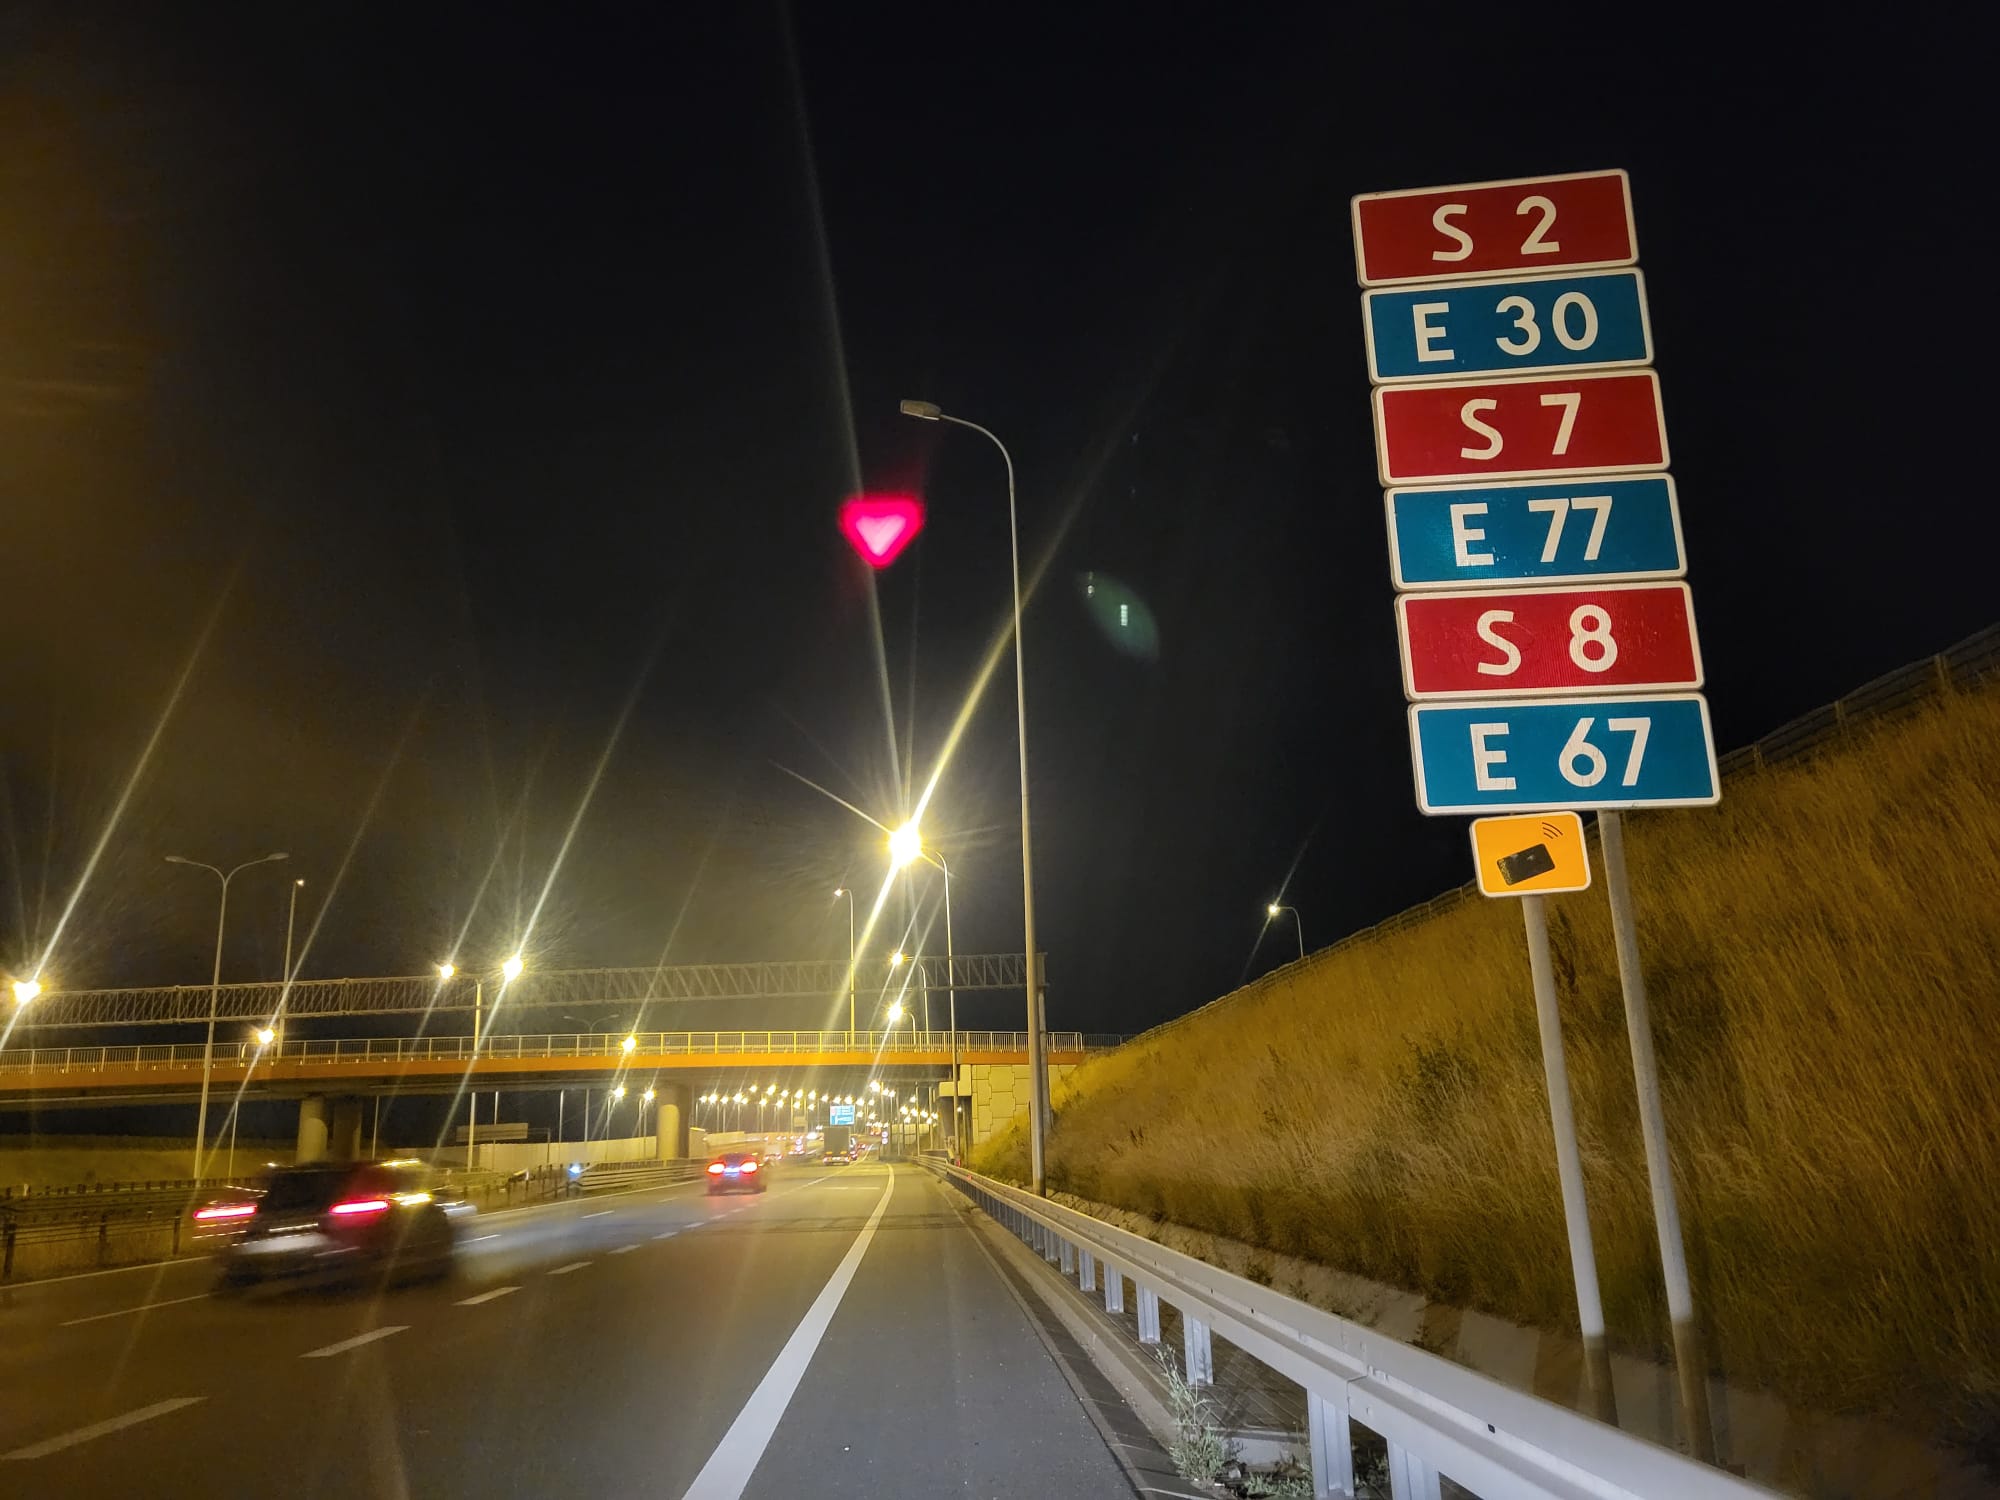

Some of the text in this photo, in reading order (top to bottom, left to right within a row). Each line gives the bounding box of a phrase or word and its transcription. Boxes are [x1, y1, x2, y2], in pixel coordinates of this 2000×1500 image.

[1432, 195, 1560, 262] S 2
[1412, 291, 1599, 363] E 30
[1460, 392, 1582, 460] S 7
[1449, 495, 1613, 567] E 77
[1476, 604, 1618, 676] S 8
[1469, 716, 1652, 792] E 67
